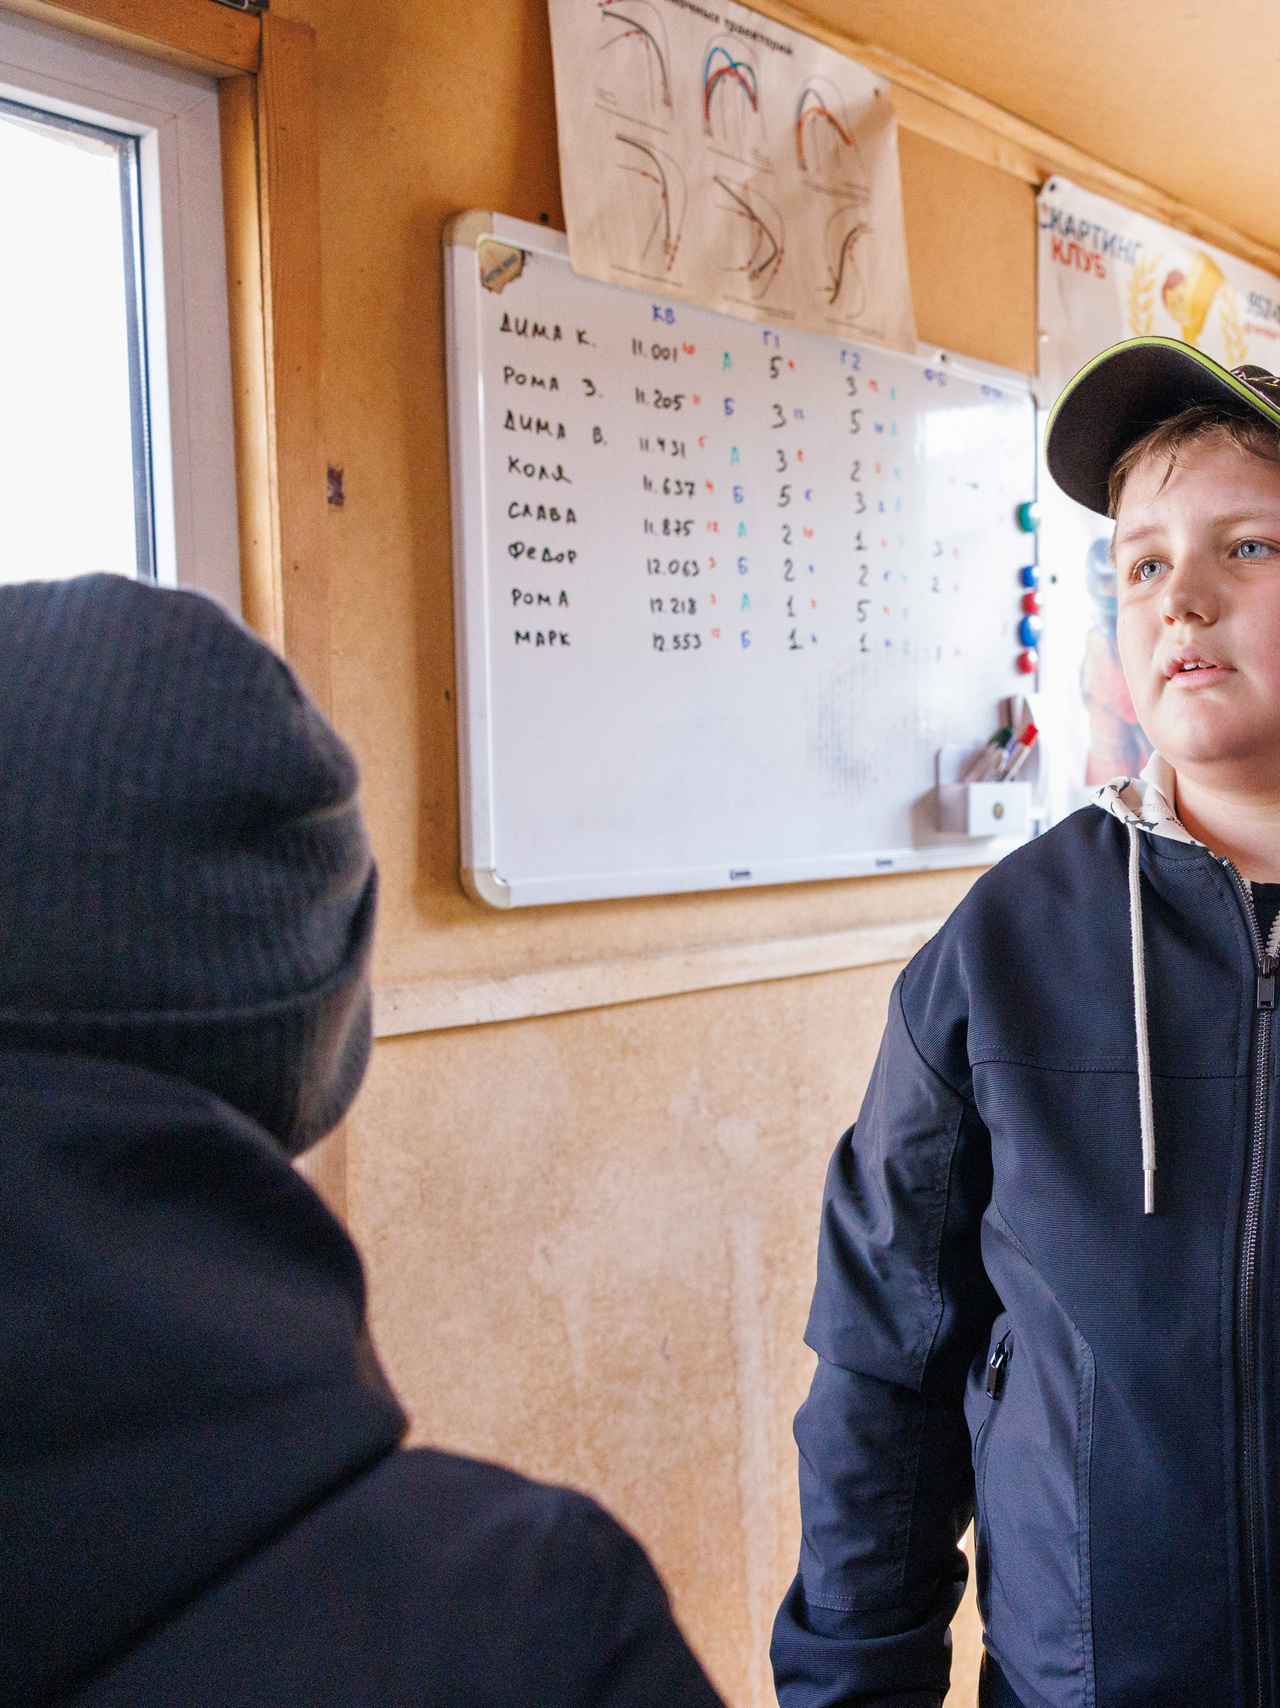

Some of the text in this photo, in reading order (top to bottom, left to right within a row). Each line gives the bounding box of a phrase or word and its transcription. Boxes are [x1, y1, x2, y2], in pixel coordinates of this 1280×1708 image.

[1051, 235, 1106, 279] КЛУБ
[500, 313, 562, 341] ДИМА
[632, 337, 679, 363] 11.001
[770, 355, 782, 379] 5
[846, 375, 858, 397] 3
[503, 366, 559, 391] РОМА
[635, 388, 685, 411] 11.205
[771, 403, 788, 430] 3
[849, 409, 862, 435] 5
[504, 410, 566, 439] ДИМА
[776, 449, 788, 473] 3
[850, 460, 861, 482] 2
[643, 476, 695, 497] 11.637
[778, 485, 791, 508] 5
[855, 491, 867, 514] 3
[508, 502, 577, 523] СЛАВА
[644, 518, 694, 536] 11.875
[782, 524, 792, 545] 2
[647, 558, 700, 577] 12.063
[784, 558, 794, 582] 2
[858, 564, 868, 587] 2
[511, 588, 568, 606] РОМА
[650, 597, 696, 615] 12.218
[857, 599, 871, 623] 5
[514, 630, 569, 647] МАРК
